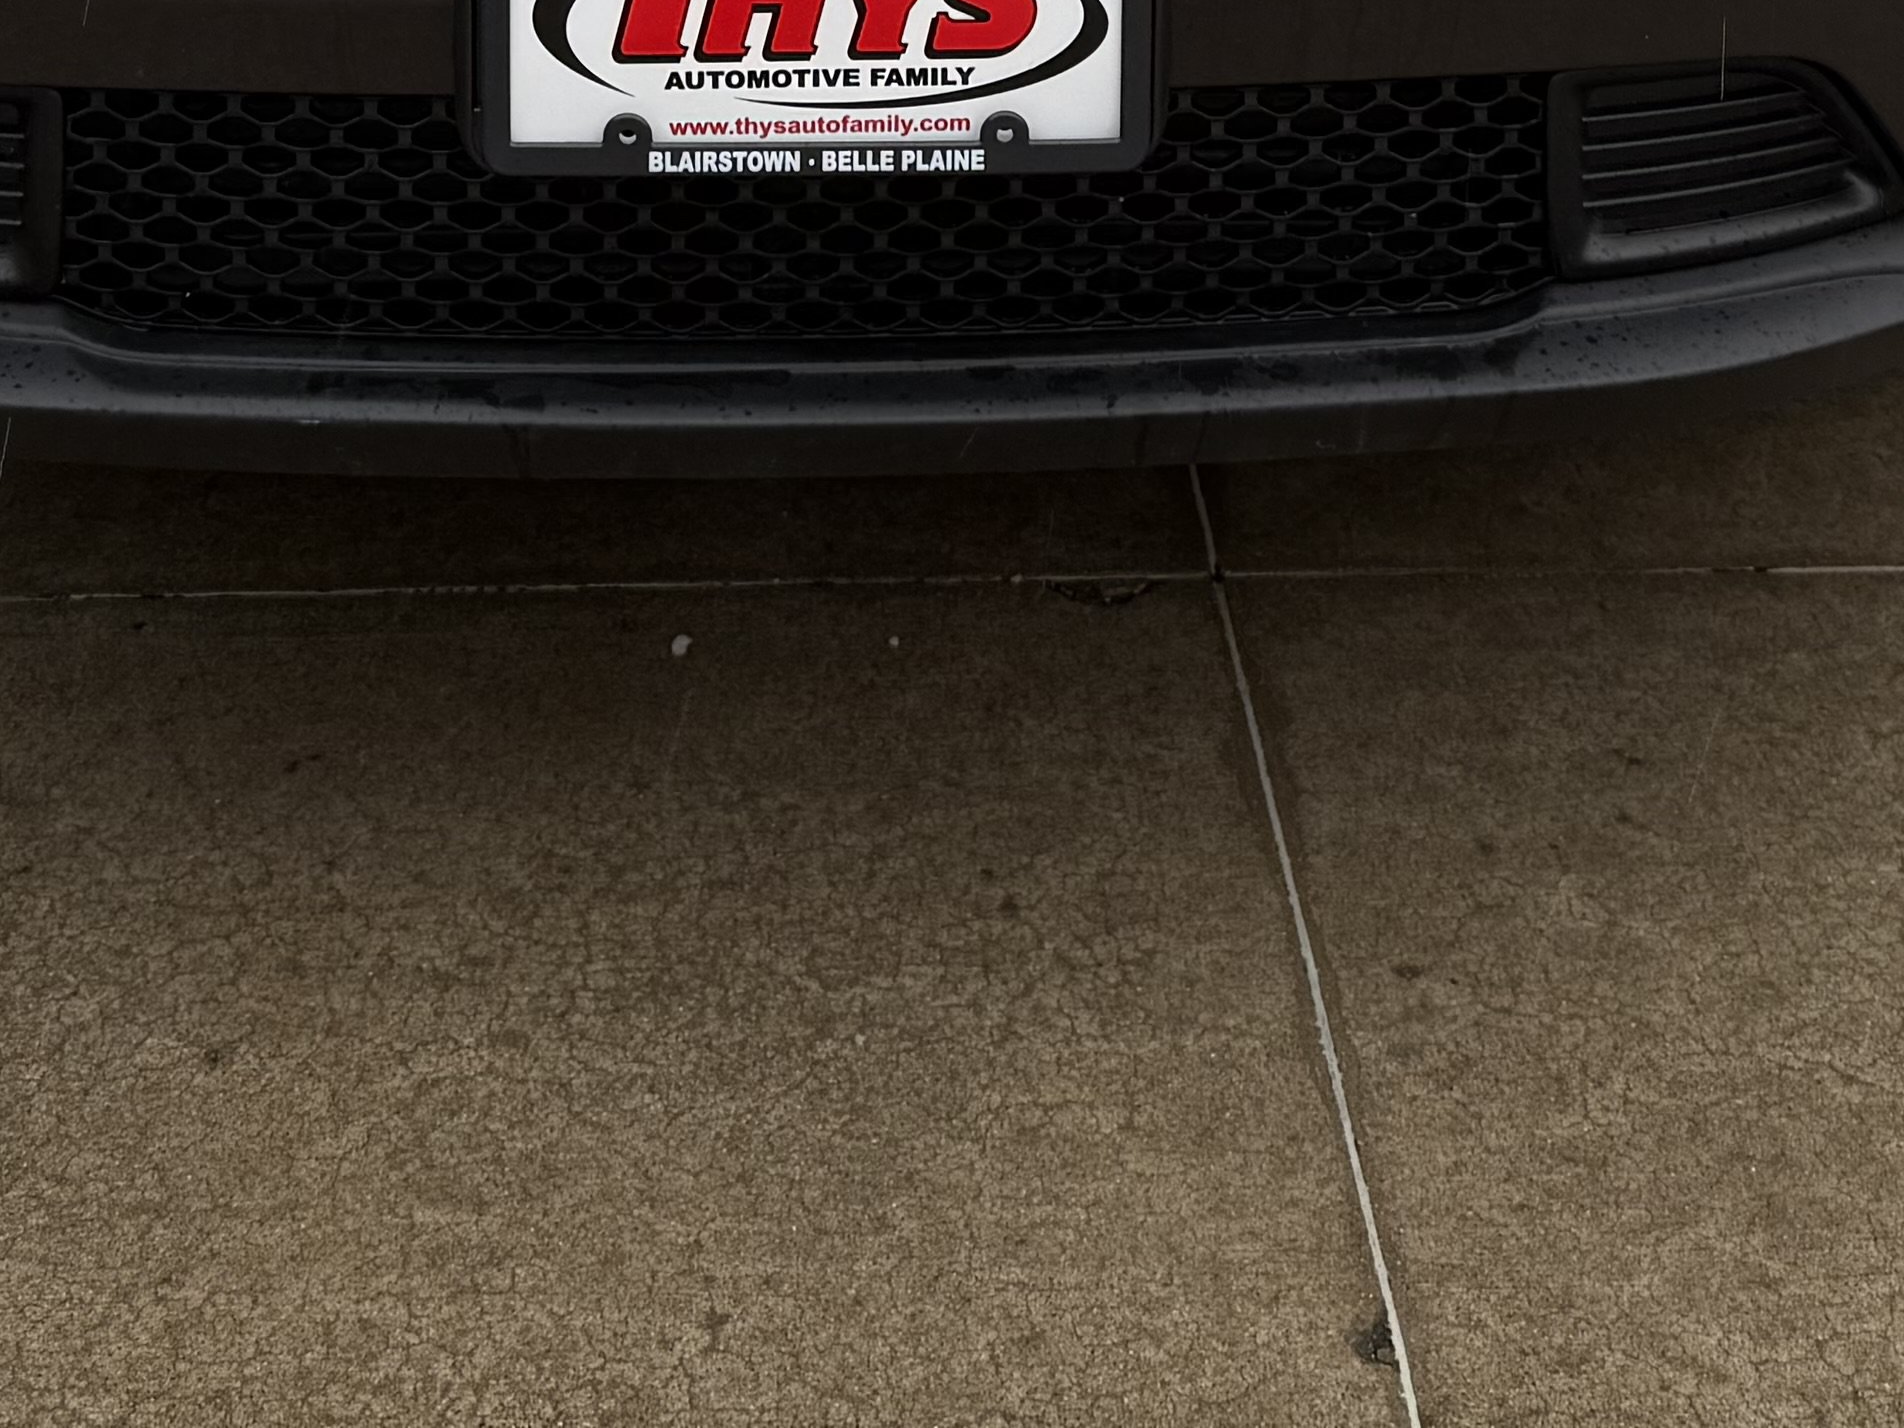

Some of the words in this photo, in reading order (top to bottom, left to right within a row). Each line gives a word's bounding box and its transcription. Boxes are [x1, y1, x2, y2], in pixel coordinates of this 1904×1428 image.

[664, 68, 861, 91] AUTOMOTIVE
[870, 66, 976, 87] FAMILY
[669, 114, 972, 139] www.thysautofamily.com
[648, 150, 802, 174] BLAIRSTOWN
[821, 149, 896, 173] BELLE
[901, 148, 986, 172] PLAINE
